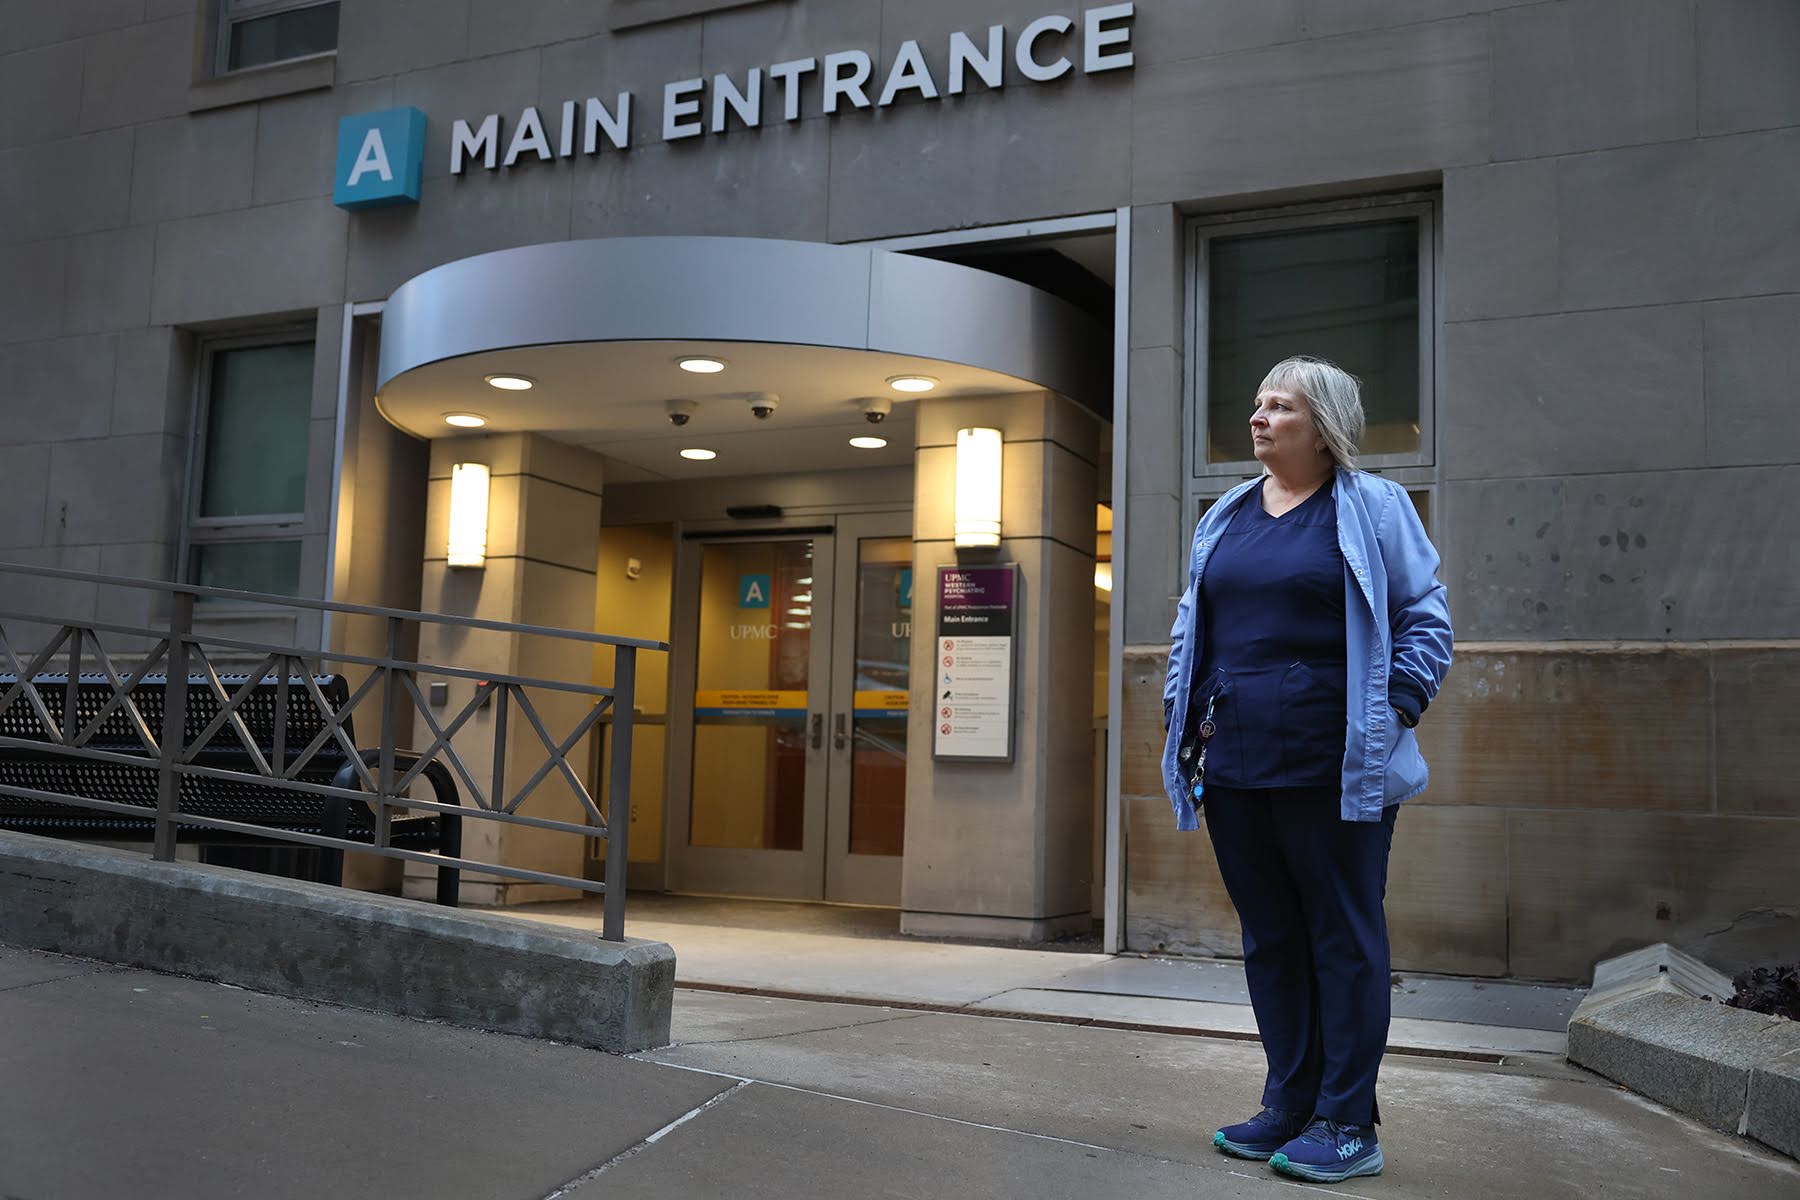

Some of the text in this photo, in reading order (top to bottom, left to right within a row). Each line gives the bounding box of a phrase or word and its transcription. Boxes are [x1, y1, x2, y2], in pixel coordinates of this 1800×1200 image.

[450, 2, 1134, 174] MAIN ENTRANCE
[346, 128, 393, 186] A
[944, 573, 971, 582] UPMC
[745, 581, 764, 602] A
[944, 615, 989, 623] Main Entrance
[730, 623, 778, 639] UPMC
[1336, 1136, 1364, 1160] HOKA
